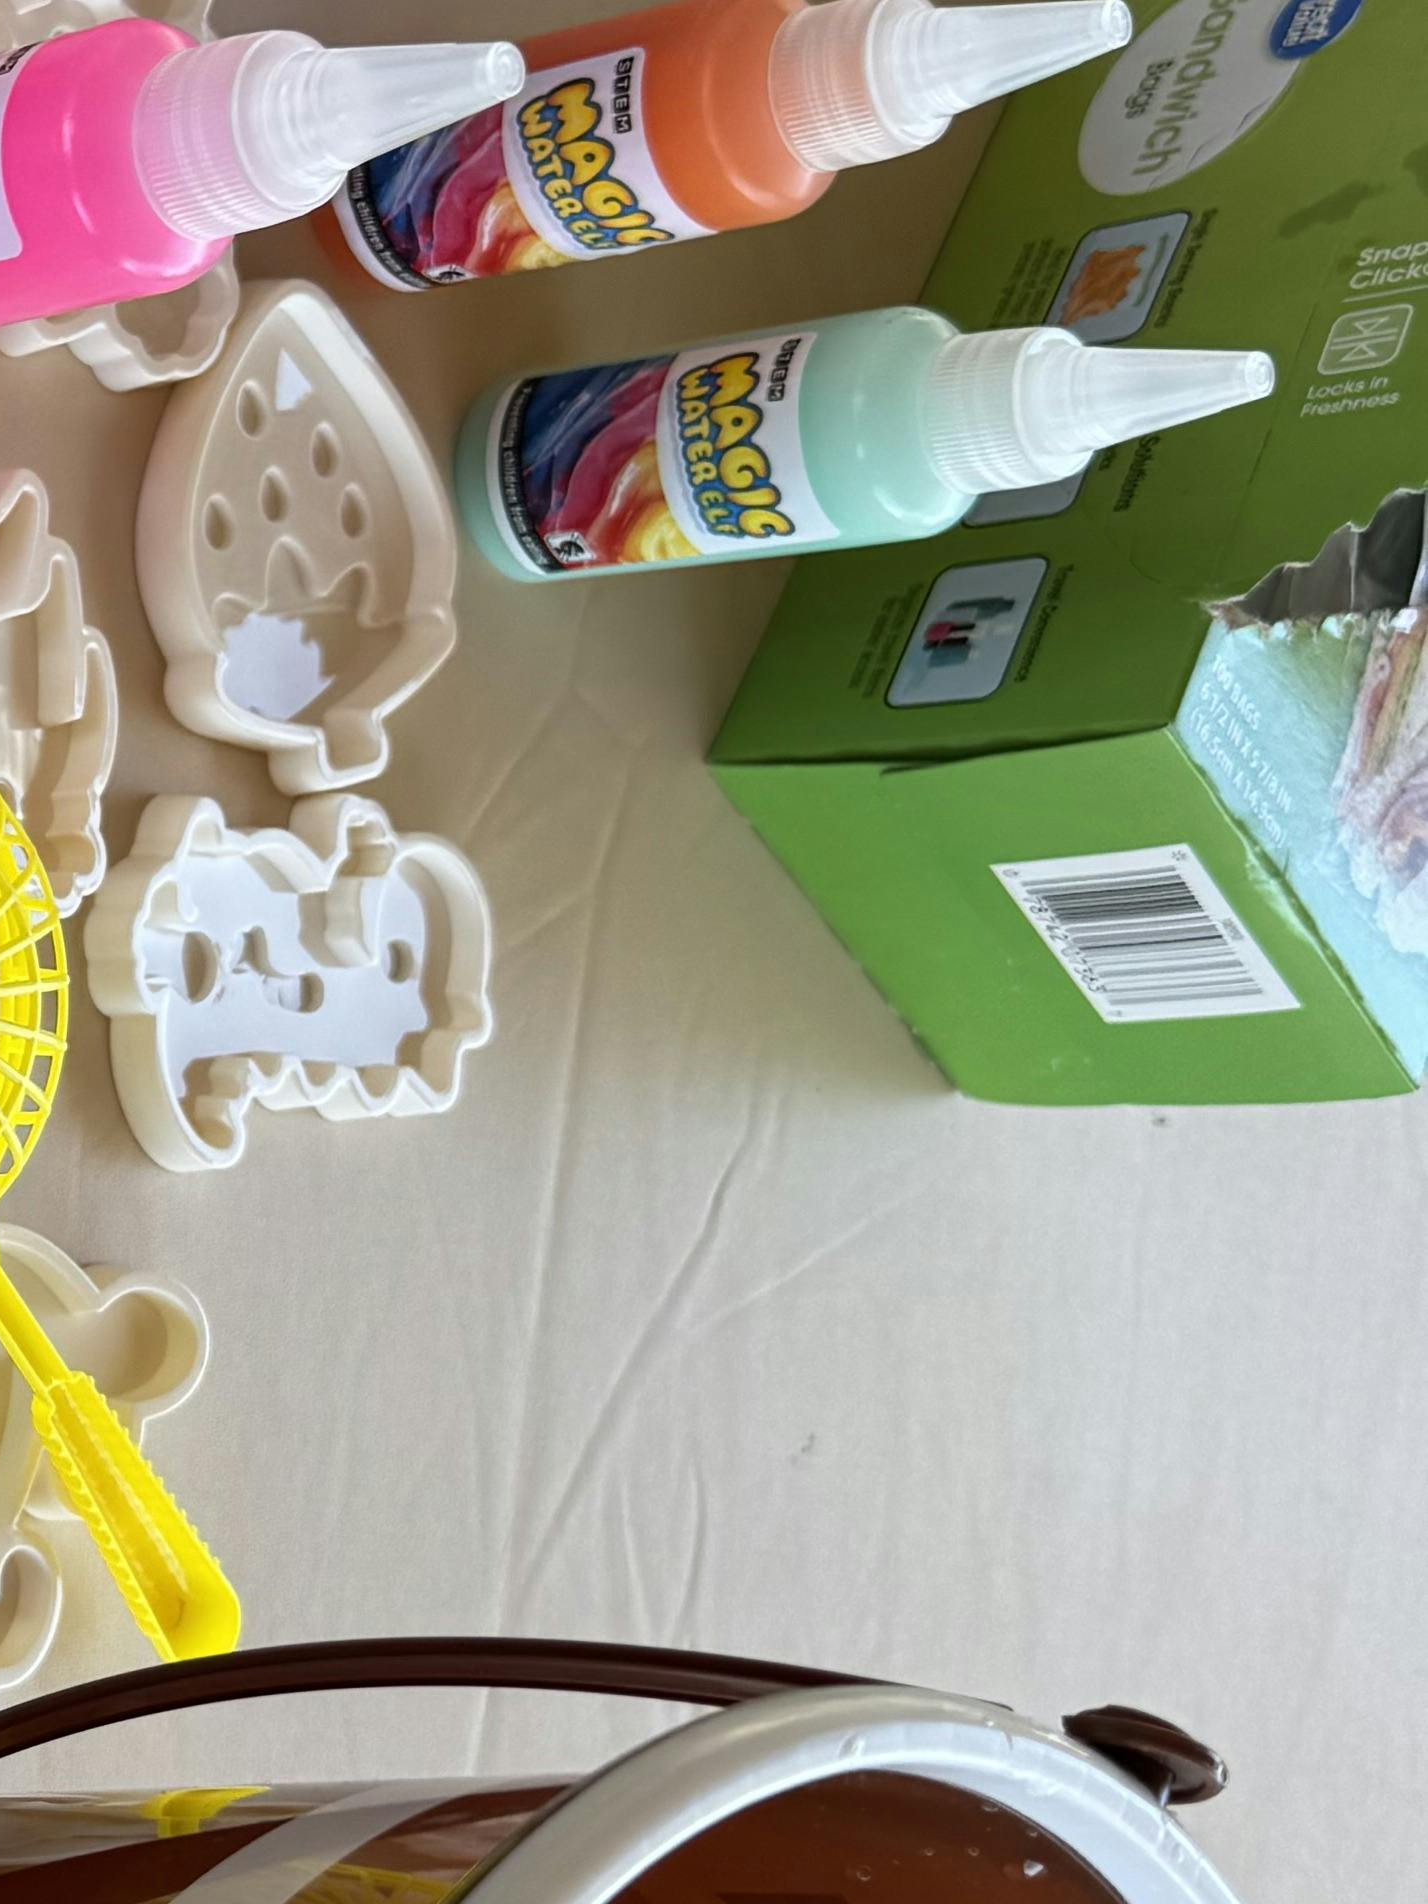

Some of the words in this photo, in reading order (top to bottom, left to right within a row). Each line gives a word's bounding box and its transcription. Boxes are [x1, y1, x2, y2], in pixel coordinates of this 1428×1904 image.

[613, 56, 634, 134] STEM
[1125, 58, 1174, 119] Bags
[517, 100, 584, 219] WATER
[546, 78, 676, 247] MAGIC
[353, 201, 384, 254] children
[767, 338, 803, 402] STEM
[1306, 379, 1366, 400] Locks
[677, 367, 718, 488] WATER
[1300, 391, 1401, 418] Freshness
[502, 449, 519, 503] children
[707, 352, 796, 539] MAGIC
[510, 505, 528, 534] from
[694, 487, 742, 538] ELF
[1212, 654, 1234, 692] 100
[1230, 684, 1262, 731] BAGS
